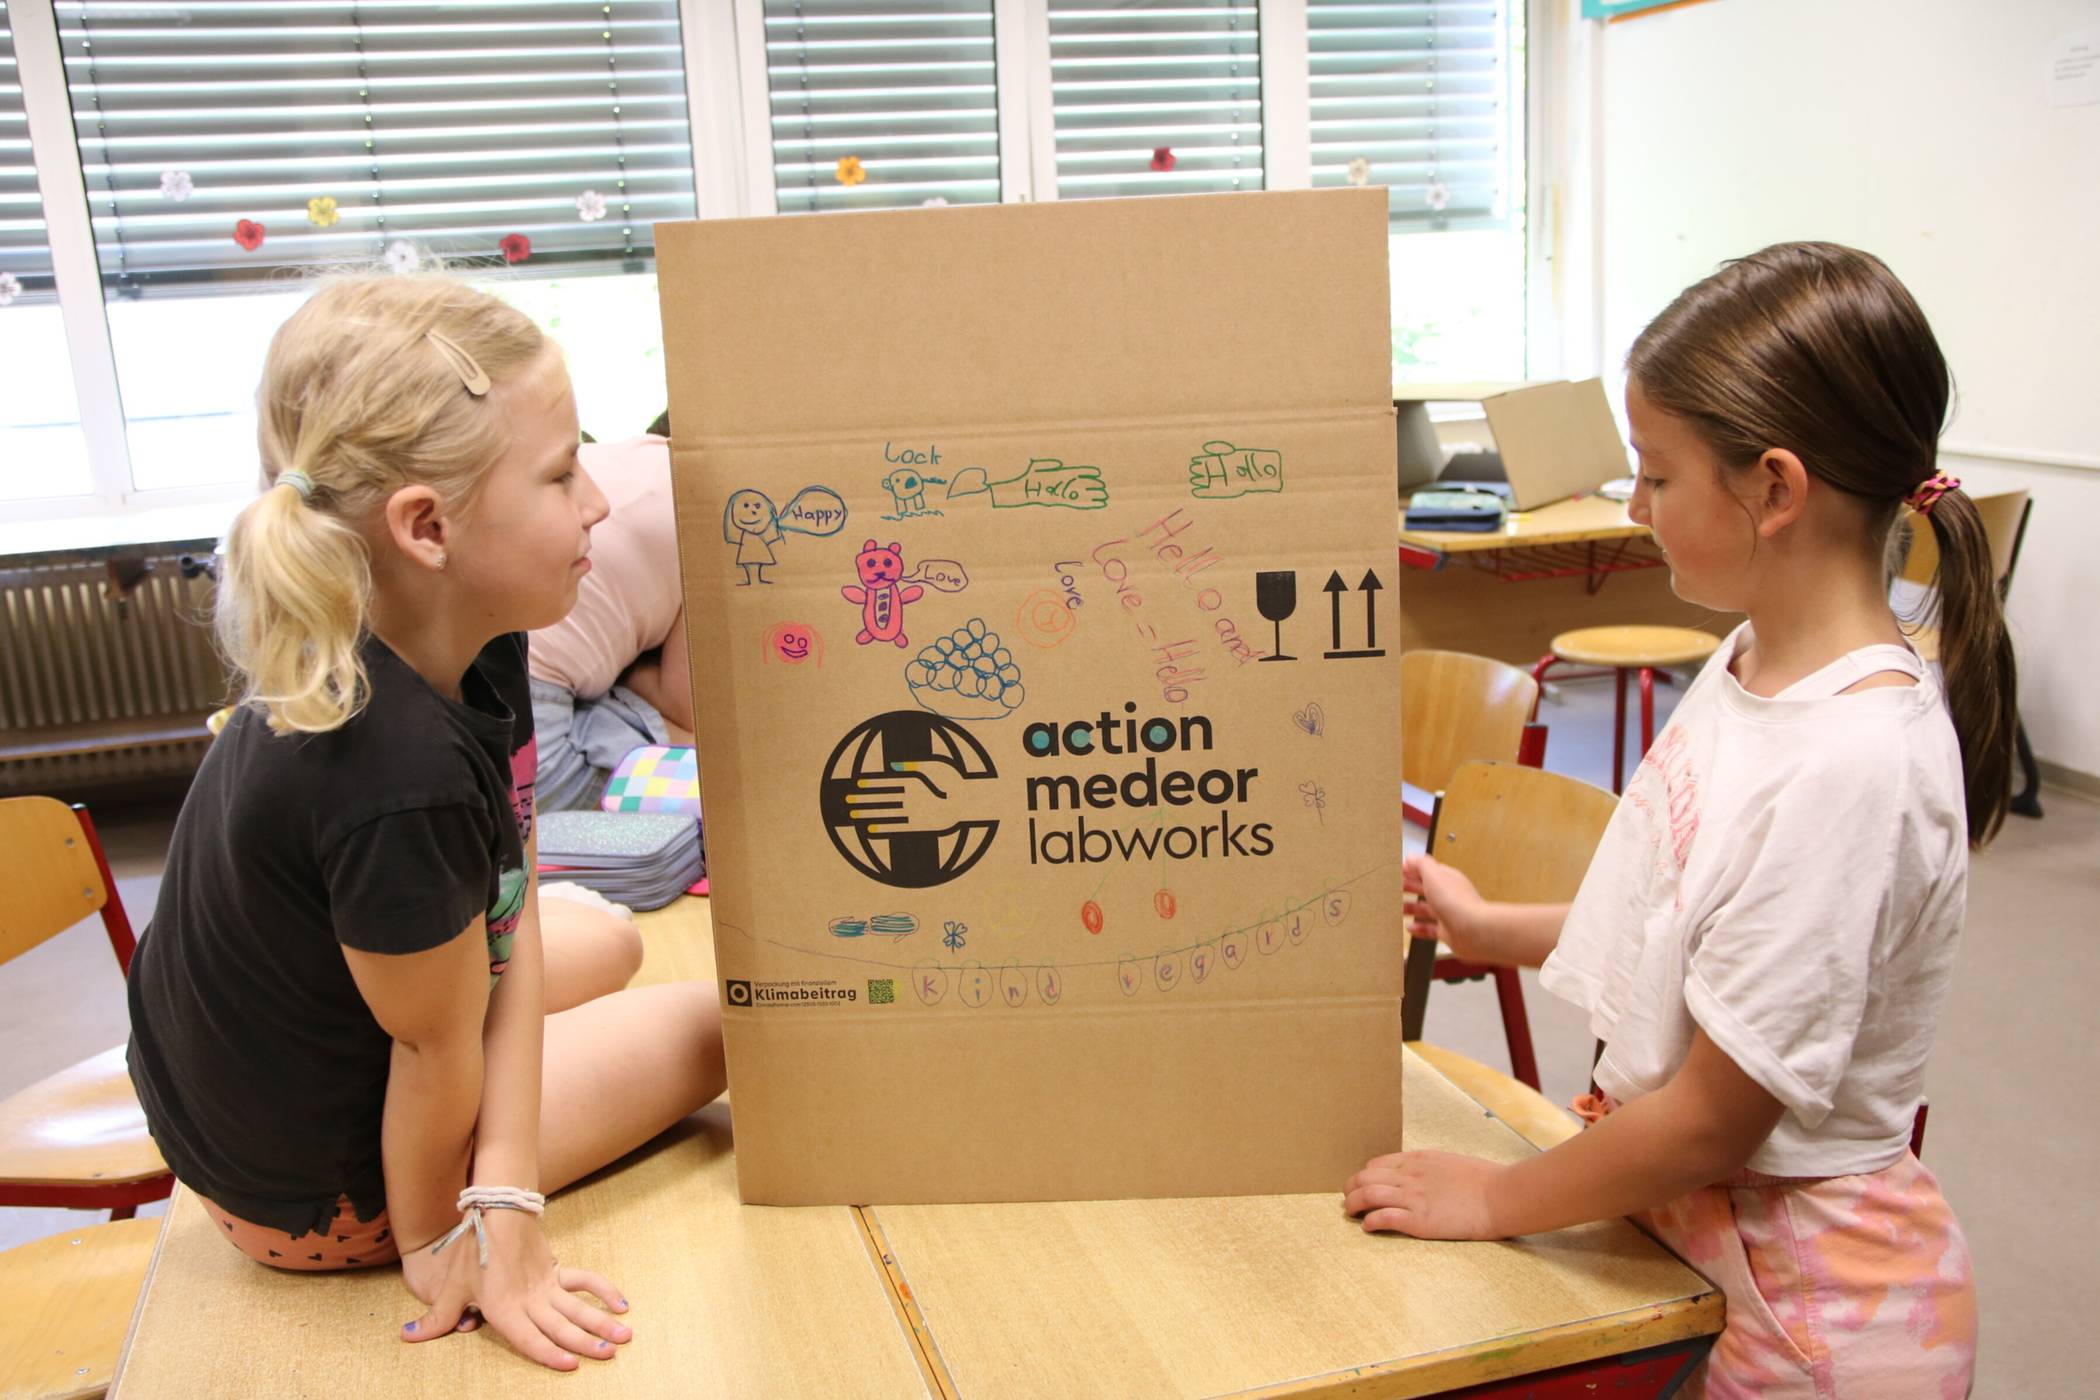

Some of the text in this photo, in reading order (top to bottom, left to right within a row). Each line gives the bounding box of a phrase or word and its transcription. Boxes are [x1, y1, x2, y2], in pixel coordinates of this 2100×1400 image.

[792, 506, 843, 527] Happy
[923, 564, 962, 587] Love
[1054, 560, 1084, 611] Love
[1022, 701, 1213, 758] action
[1026, 757, 1258, 811] medeor
[1028, 810, 1274, 865] labworks
[755, 987, 857, 1001] Klimabeitrag
